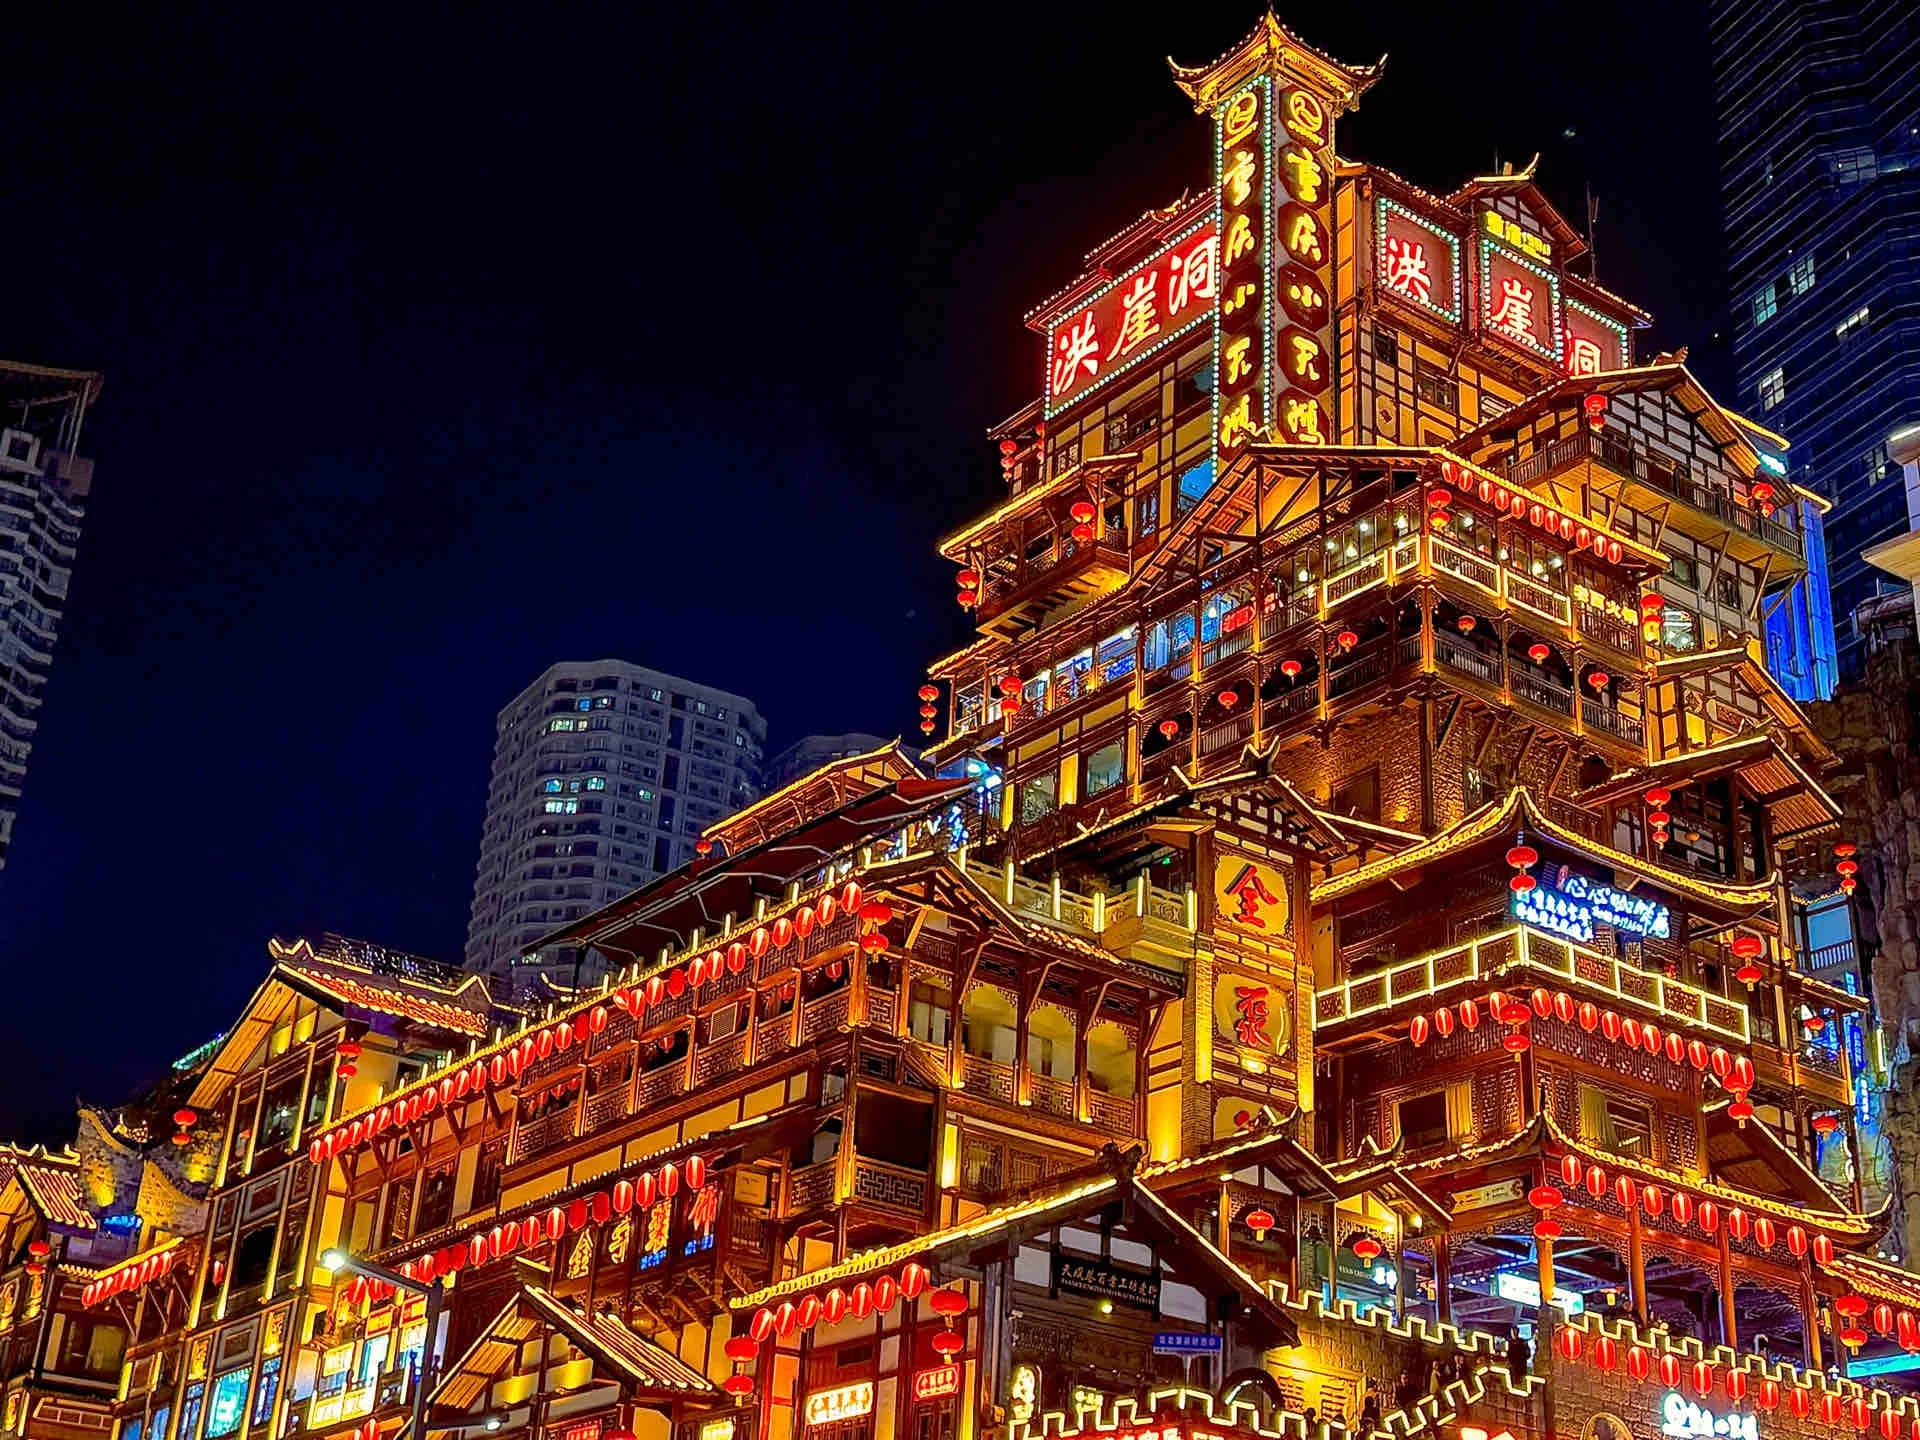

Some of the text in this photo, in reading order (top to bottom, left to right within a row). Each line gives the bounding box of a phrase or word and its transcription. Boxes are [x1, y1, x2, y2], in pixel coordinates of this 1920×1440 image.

[1053, 235, 1220, 396] 洪崖洞
[1387, 236, 1601, 379] 洪崖洞
